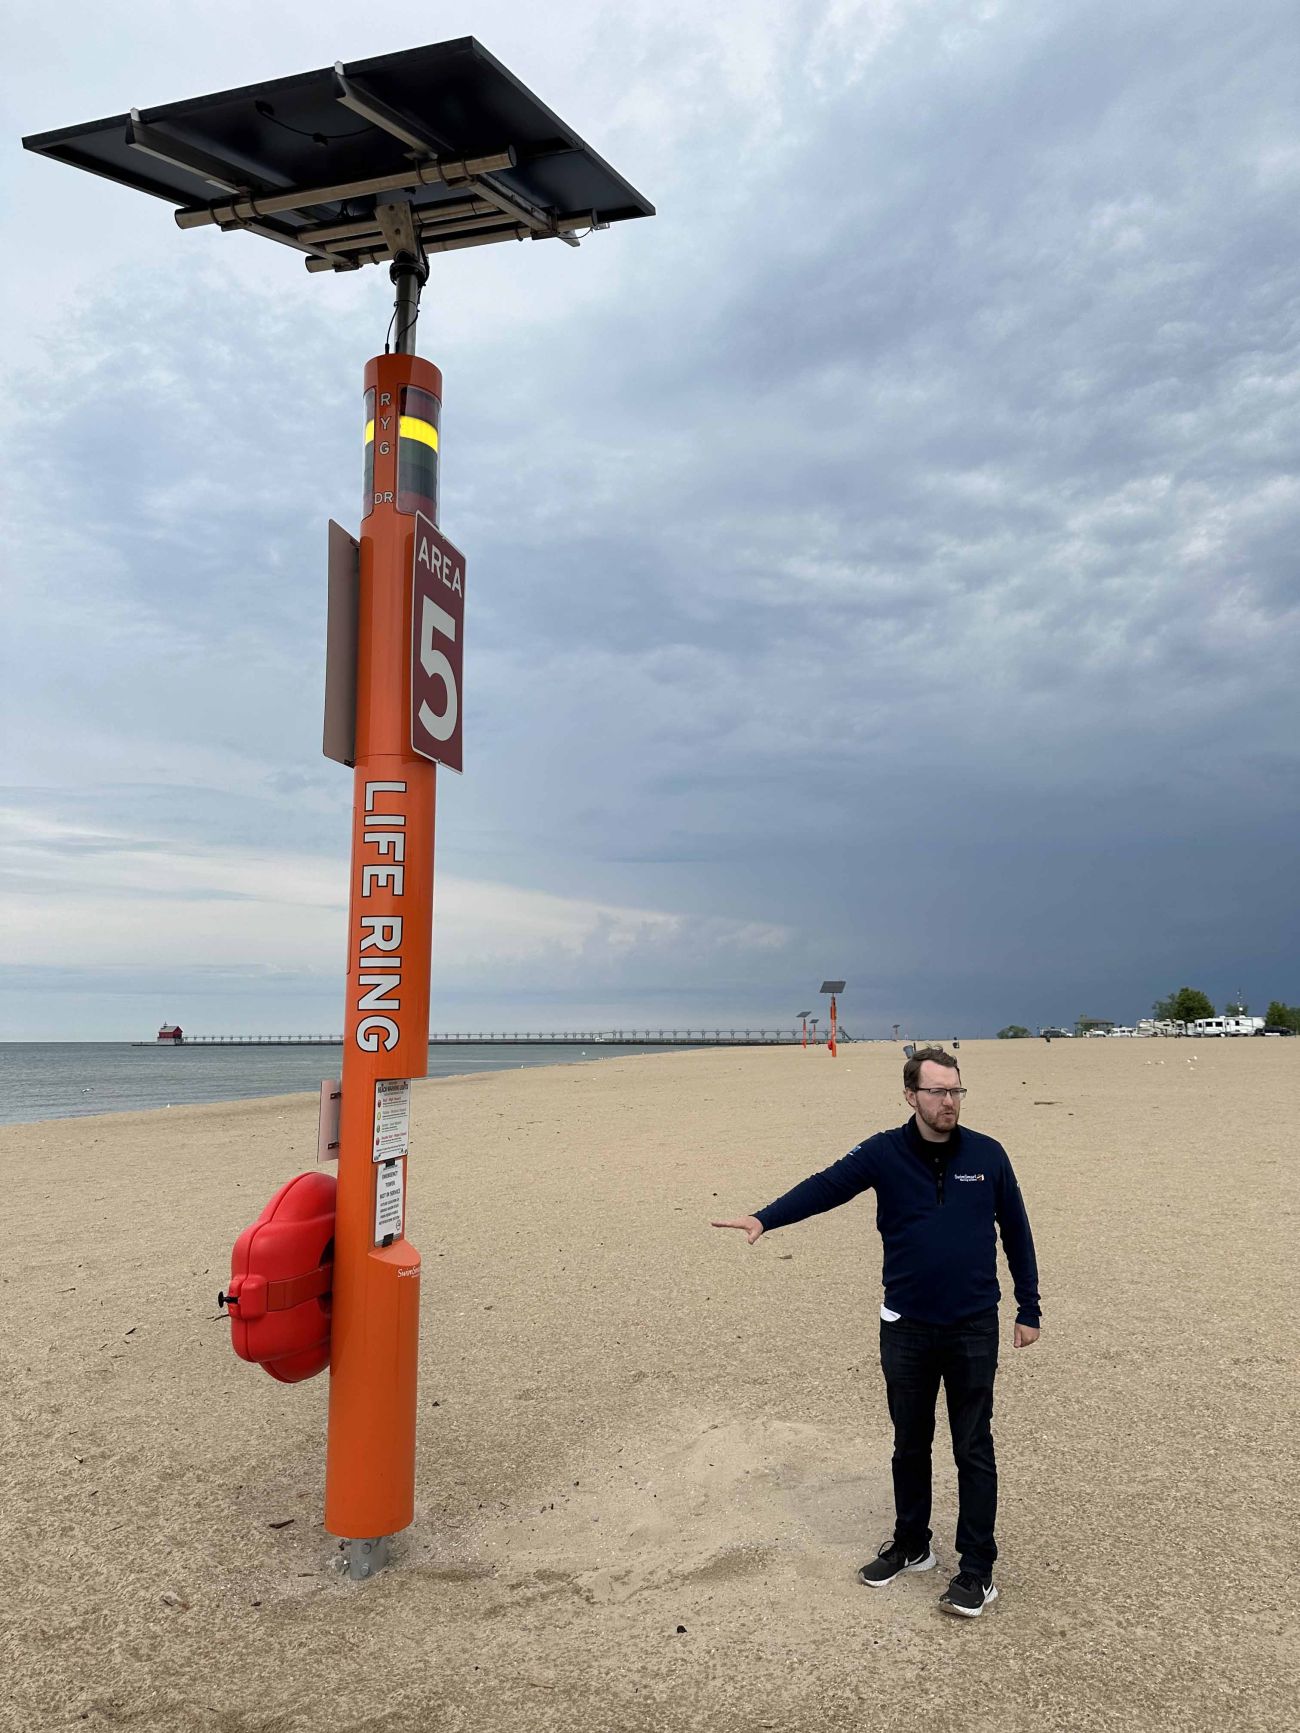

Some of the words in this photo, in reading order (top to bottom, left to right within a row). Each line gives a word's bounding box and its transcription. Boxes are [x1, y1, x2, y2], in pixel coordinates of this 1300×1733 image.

[381, 393, 391, 405] R
[381, 417, 391, 429] Y
[380, 442, 389, 454] G
[374, 491, 393, 504] DR
[418, 536, 463, 598] AREA
[418, 594, 458, 742] 5
[362, 781, 407, 898] LIFE
[355, 915, 403, 1053] RING
